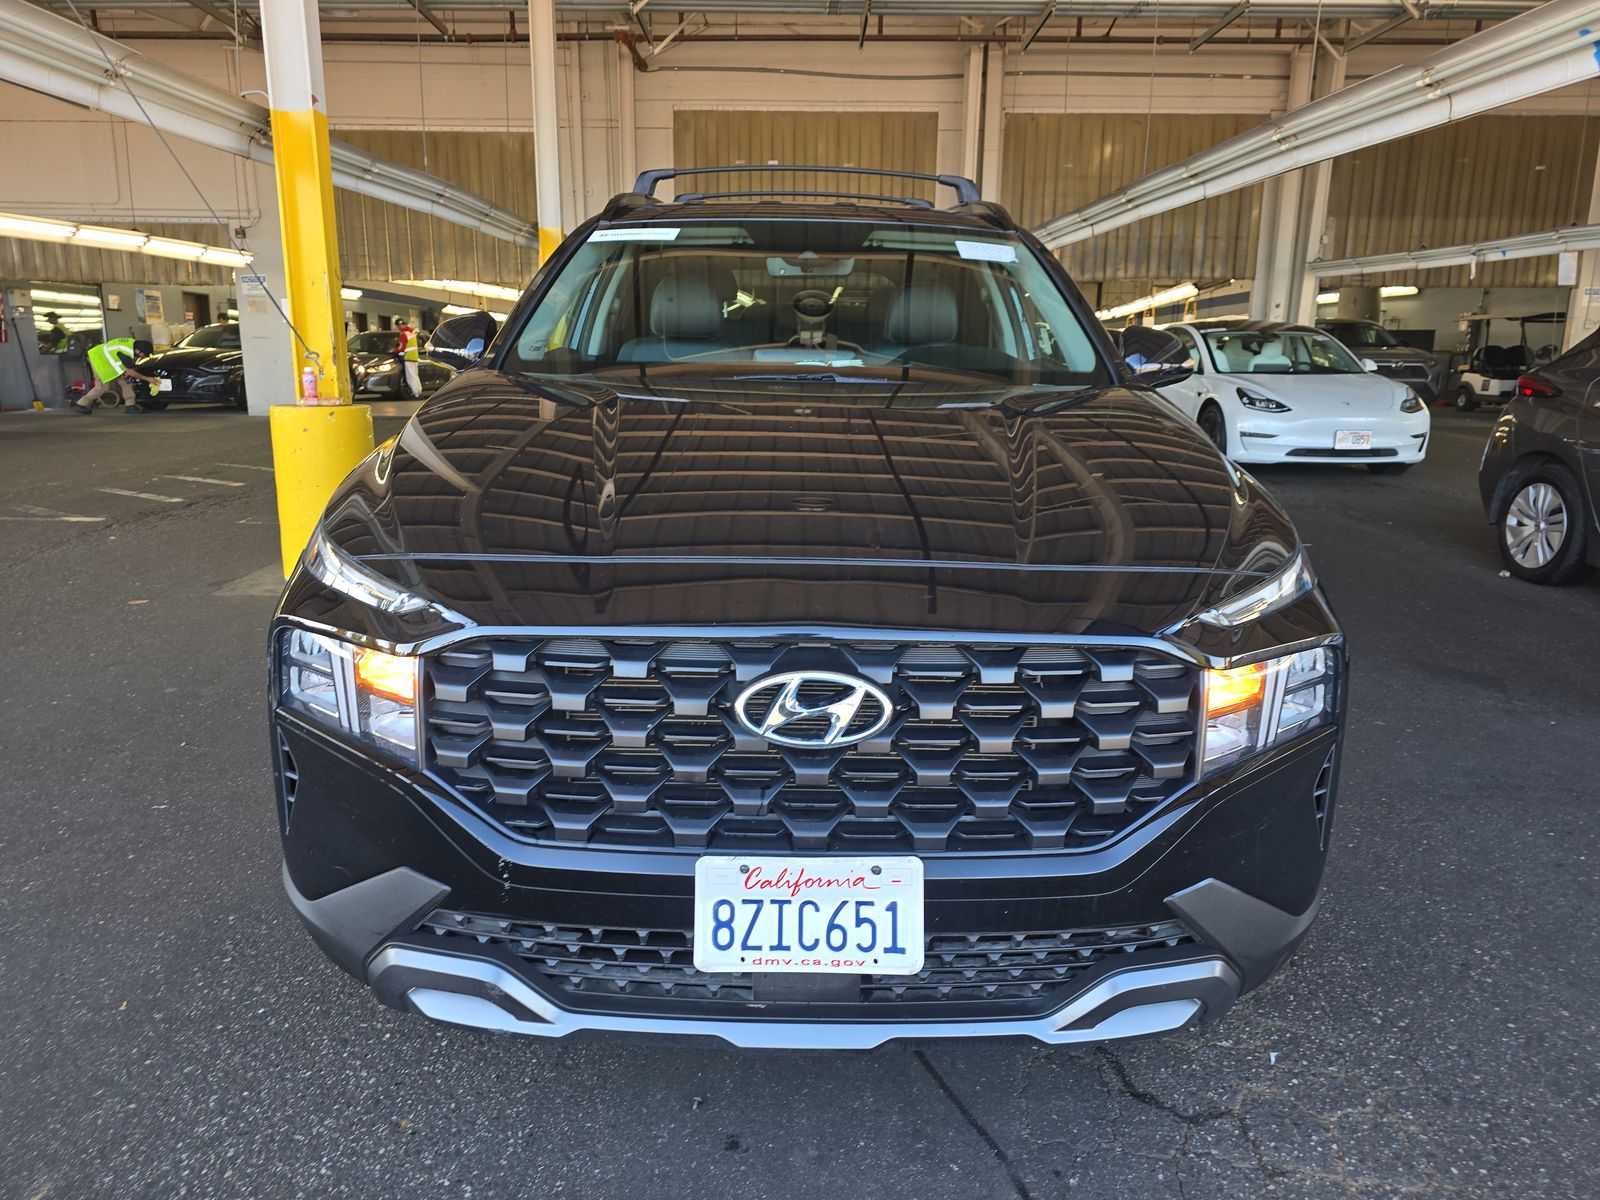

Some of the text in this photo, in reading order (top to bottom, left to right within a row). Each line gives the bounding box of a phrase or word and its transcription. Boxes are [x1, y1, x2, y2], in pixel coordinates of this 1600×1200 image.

[744, 866, 881, 896] California
[712, 898, 907, 955] 8ZIC651
[752, 957, 866, 968] dmv.ca.gov
